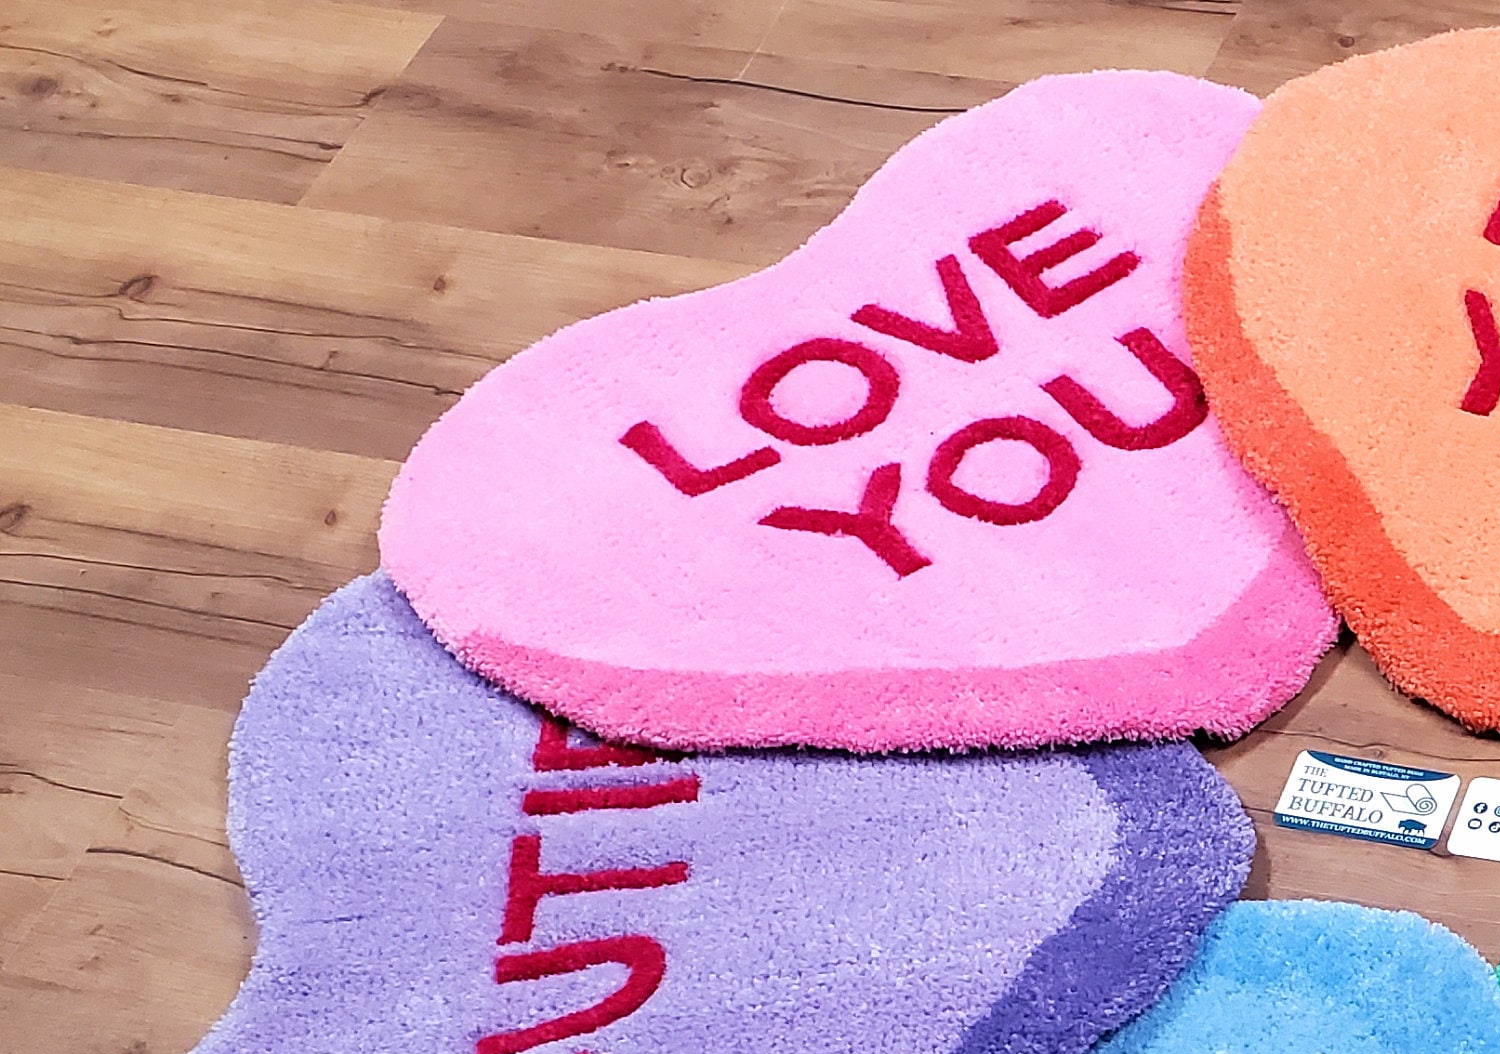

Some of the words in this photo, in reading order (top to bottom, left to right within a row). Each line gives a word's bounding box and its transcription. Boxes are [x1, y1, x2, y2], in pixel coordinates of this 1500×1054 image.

[621, 202, 1138, 497] LOVE
[760, 328, 1211, 577] YOU
[1304, 765, 1329, 778] THE
[1298, 777, 1374, 803] TUFTED
[1288, 795, 1383, 824] BUFFALO
[1281, 815, 1426, 845] WWW.THETUFTEDBUFFALO.COM
